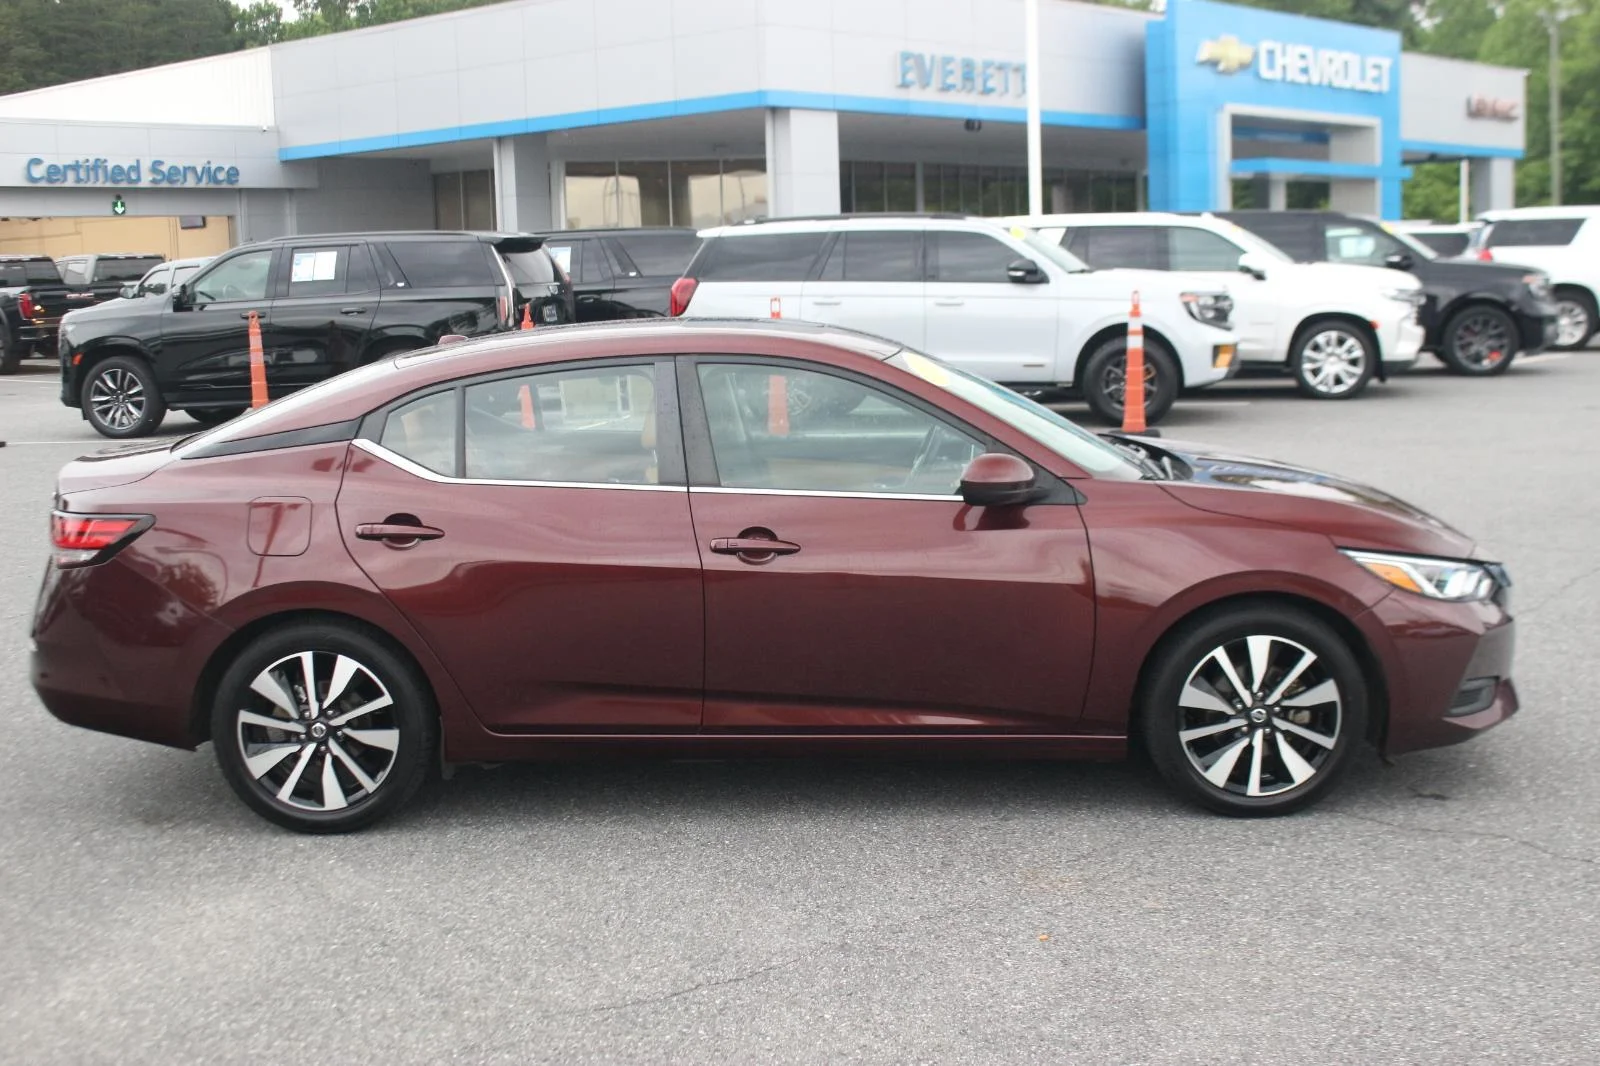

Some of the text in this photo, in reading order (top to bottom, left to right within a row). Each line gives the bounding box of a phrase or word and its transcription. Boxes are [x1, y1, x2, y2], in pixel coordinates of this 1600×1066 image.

[1258, 40, 1392, 93] CHEVROLET
[26, 158, 240, 185] Certified Service
